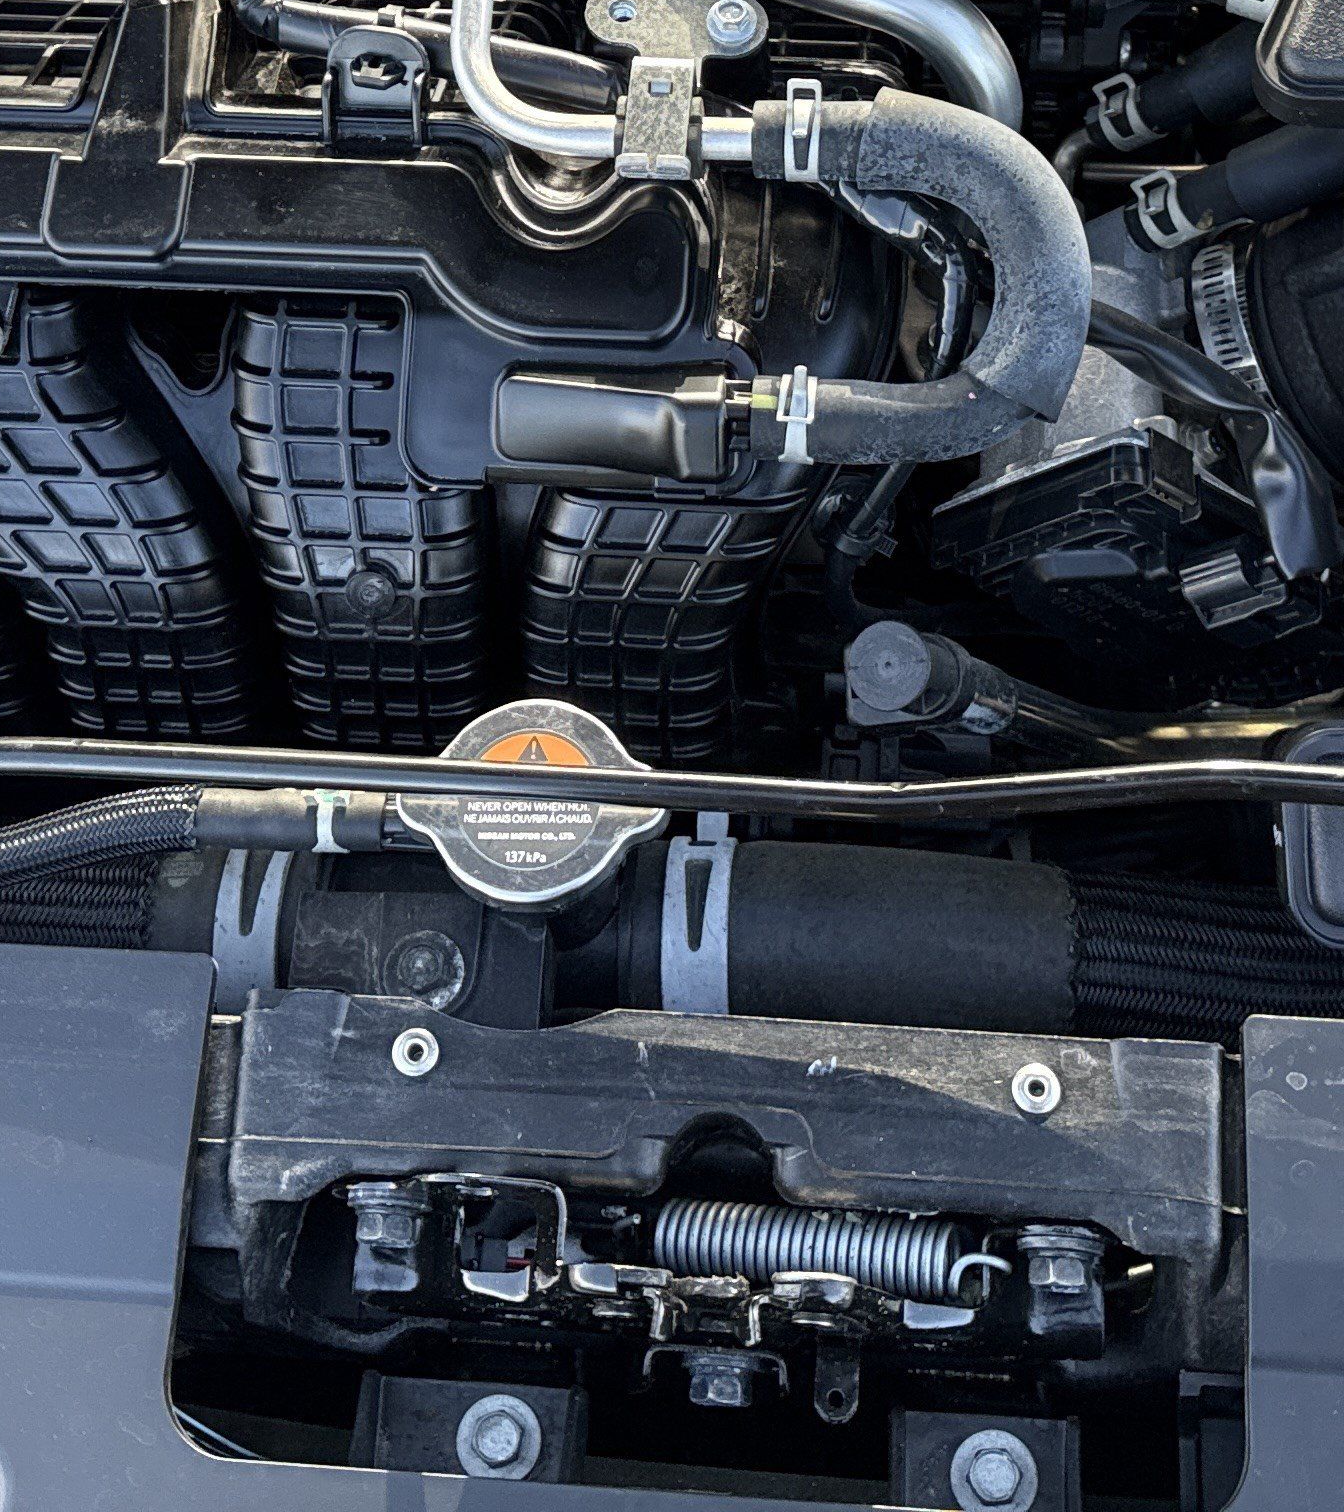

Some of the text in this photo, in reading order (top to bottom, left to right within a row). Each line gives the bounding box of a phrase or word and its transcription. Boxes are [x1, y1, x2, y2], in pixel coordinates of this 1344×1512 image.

[467, 802, 502, 812] NEVER
[503, 802, 533, 812] OPEN
[534, 802, 566, 812] WHEN
[504, 850, 547, 863] 137 kPa
